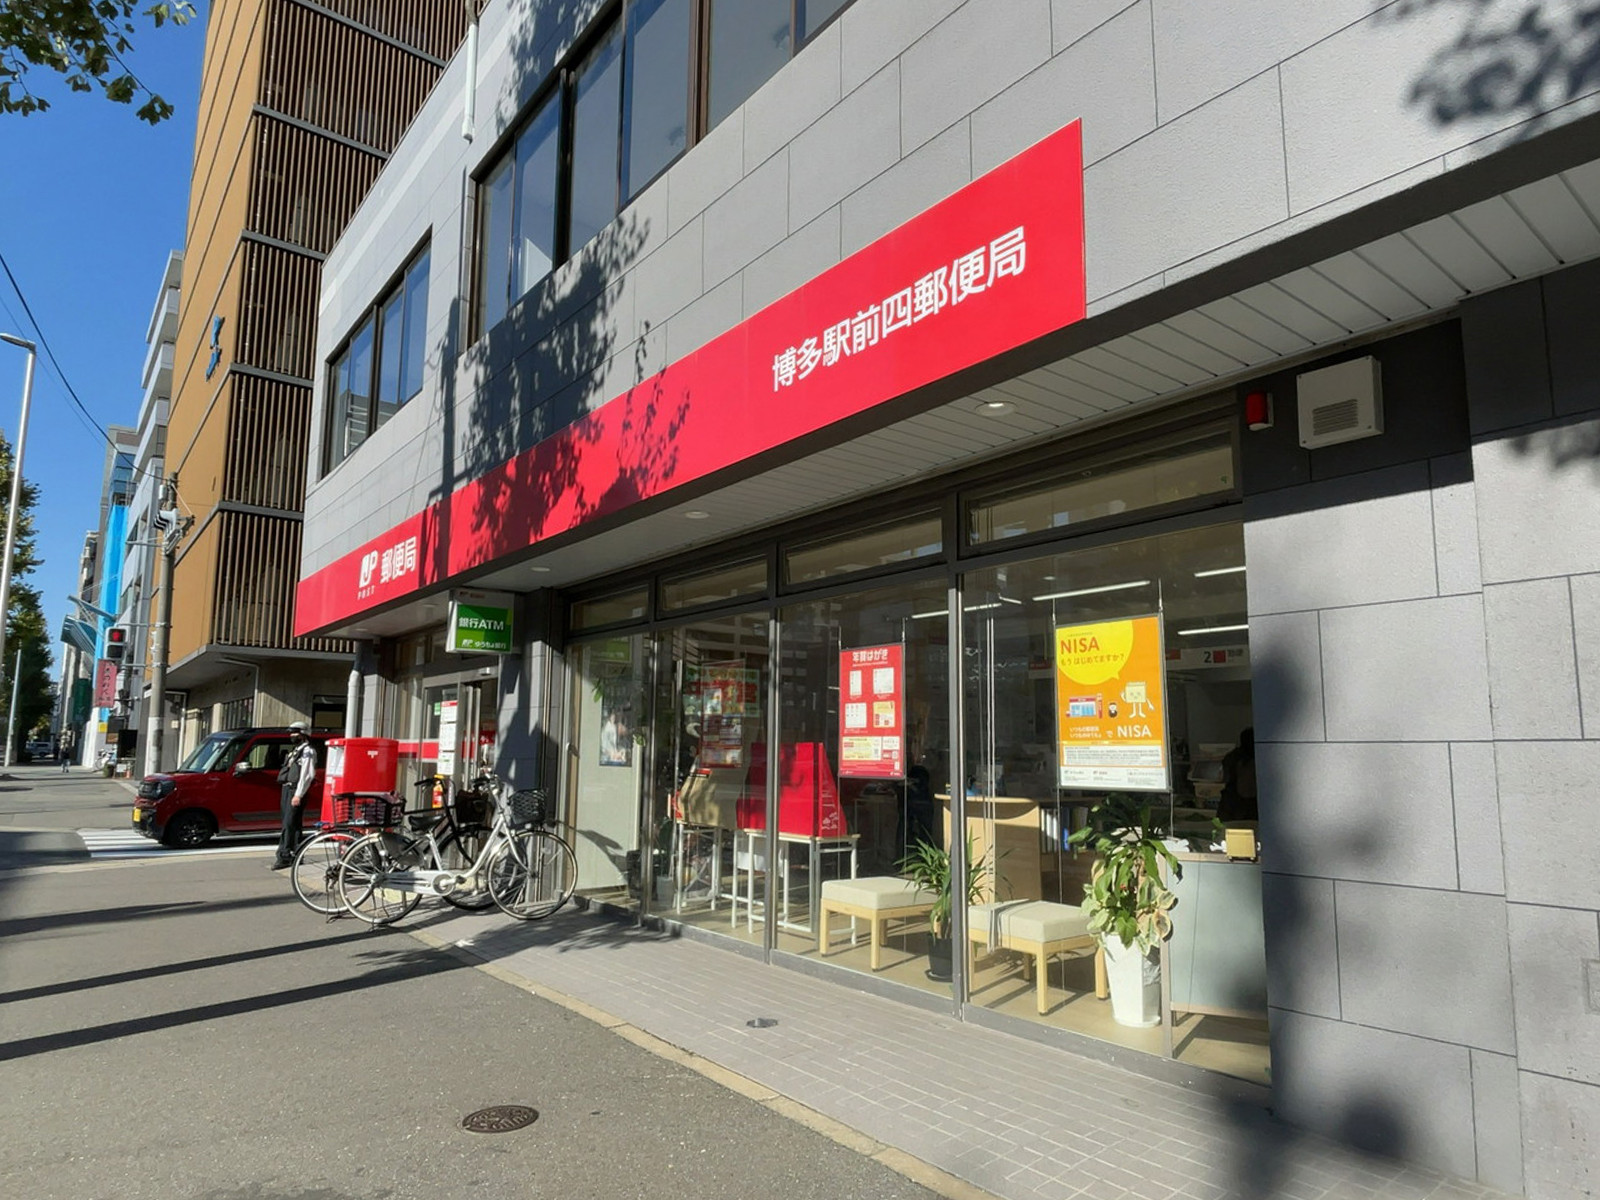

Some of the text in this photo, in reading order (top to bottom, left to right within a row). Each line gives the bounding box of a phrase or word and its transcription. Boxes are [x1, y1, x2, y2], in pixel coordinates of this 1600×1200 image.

[772, 225, 1027, 392] 博多駅前四郵便局
[380, 536, 416, 584] 郵便局
[357, 585, 376, 600] POST
[458, 616, 504, 631] 銀行ATM
[1060, 637, 1100, 654] NISA
[852, 649, 888, 662] 年賀はがき
[1203, 651, 1212, 663] 2
[1117, 724, 1152, 738] NISA
